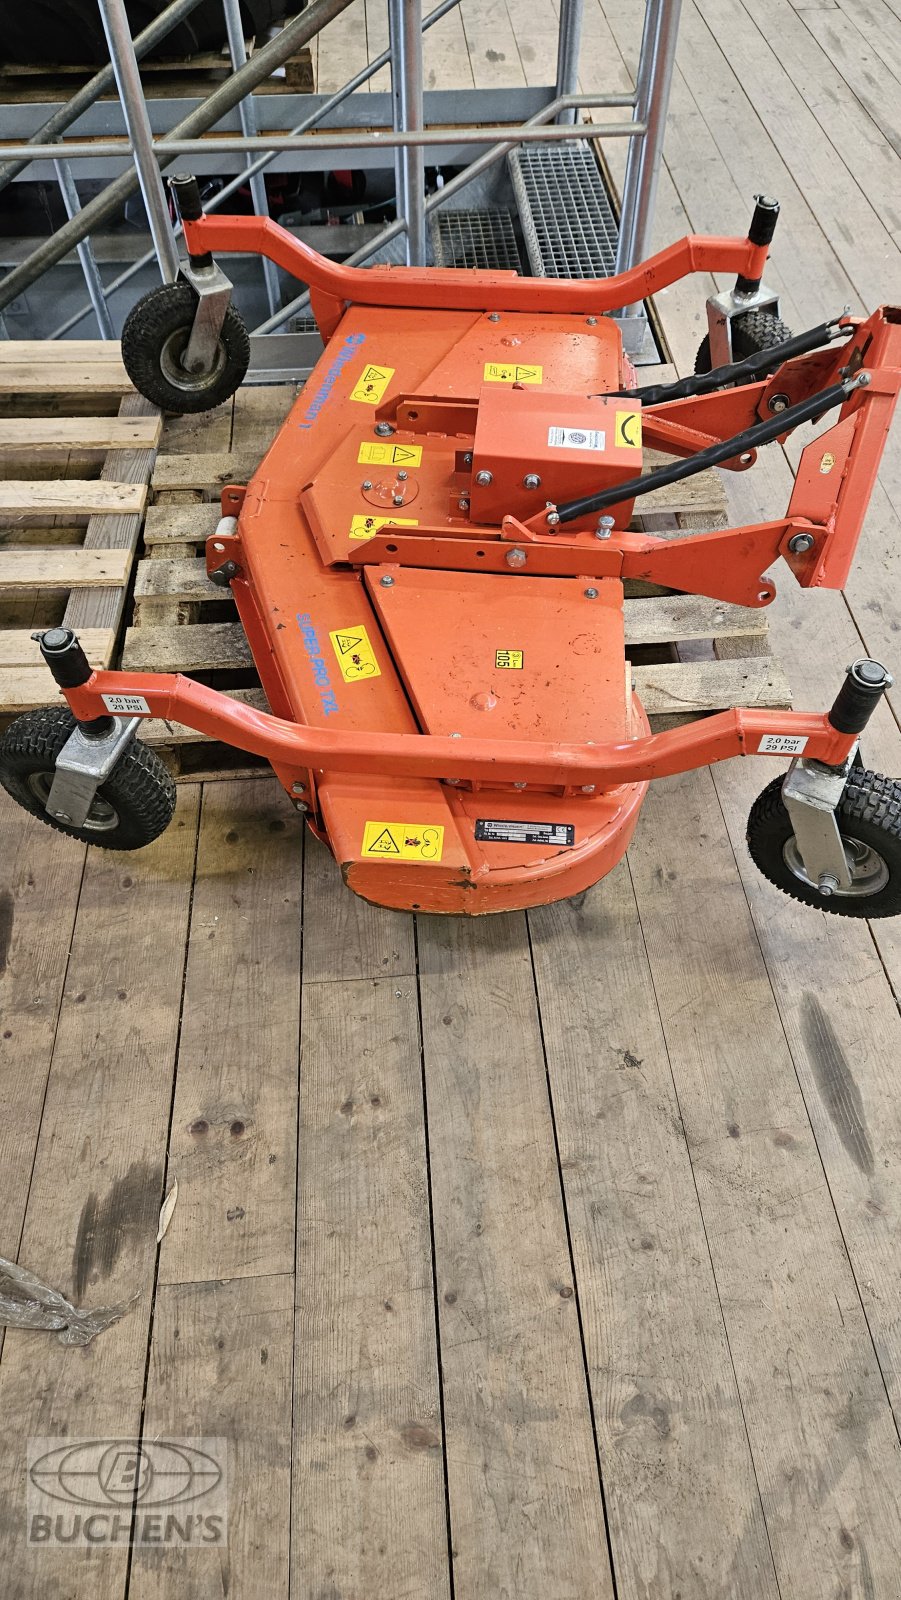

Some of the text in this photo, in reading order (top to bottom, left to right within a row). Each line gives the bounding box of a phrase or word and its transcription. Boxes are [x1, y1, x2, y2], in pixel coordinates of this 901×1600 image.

[296, 613, 339, 716] SUPER PRO TXL
[497, 651, 510, 667] 105
